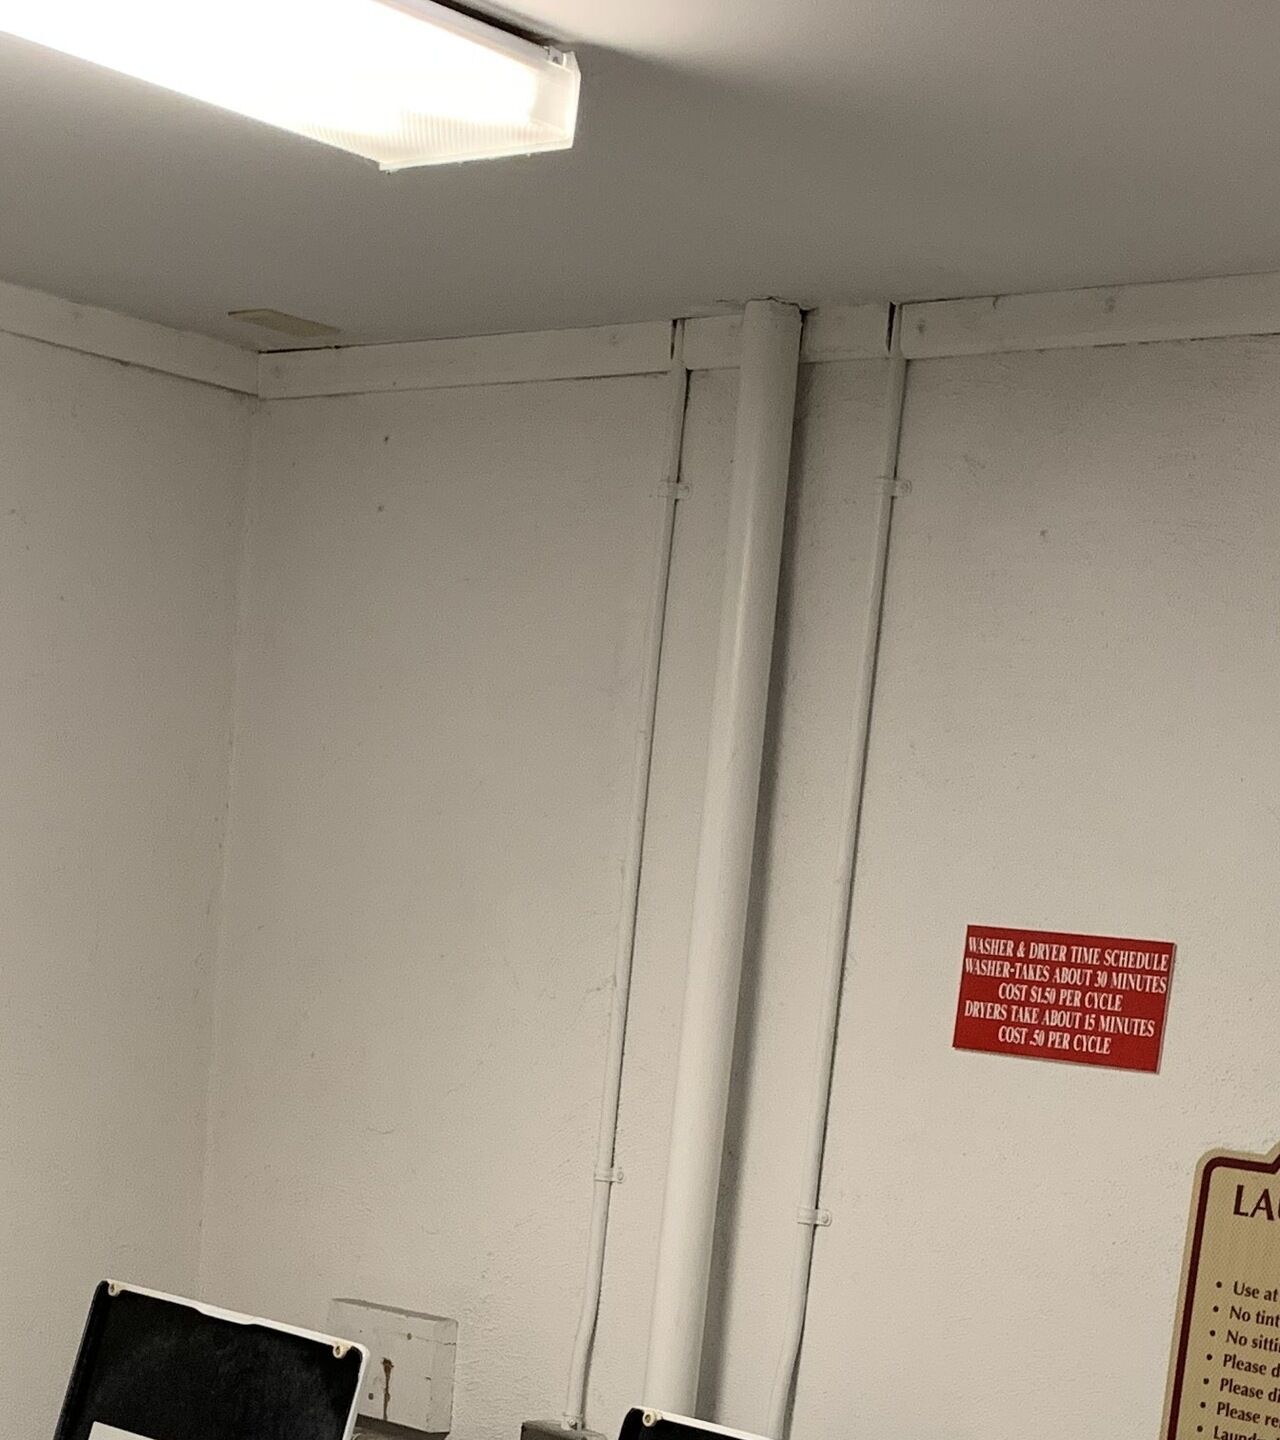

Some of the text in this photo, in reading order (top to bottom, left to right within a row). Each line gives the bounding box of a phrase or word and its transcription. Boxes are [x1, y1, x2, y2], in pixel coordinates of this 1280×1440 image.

[968, 936, 1169, 971] WASHER & DRYER TIME SCHEDULE
[965, 957, 1167, 994] WASHER-TAKES ABOUT 30 MINUTES
[998, 983, 1028, 1001] COST
[1058, 988, 1082, 1007] PER
[1084, 991, 1123, 1011] CYCLE
[964, 1000, 1155, 1037] DRYERS TAKE ABOUT 15 MINUTES
[998, 1025, 1111, 1054] COST .50 PER CYCLE
[1233, 1280, 1260, 1299] Use
[1263, 1288, 1278, 1302] at
[1229, 1305, 1251, 1322] No
[1225, 1329, 1248, 1346] No
[1222, 1353, 1267, 1376] Please
[1219, 1377, 1264, 1400] Please
[1216, 1401, 1261, 1424] Please
